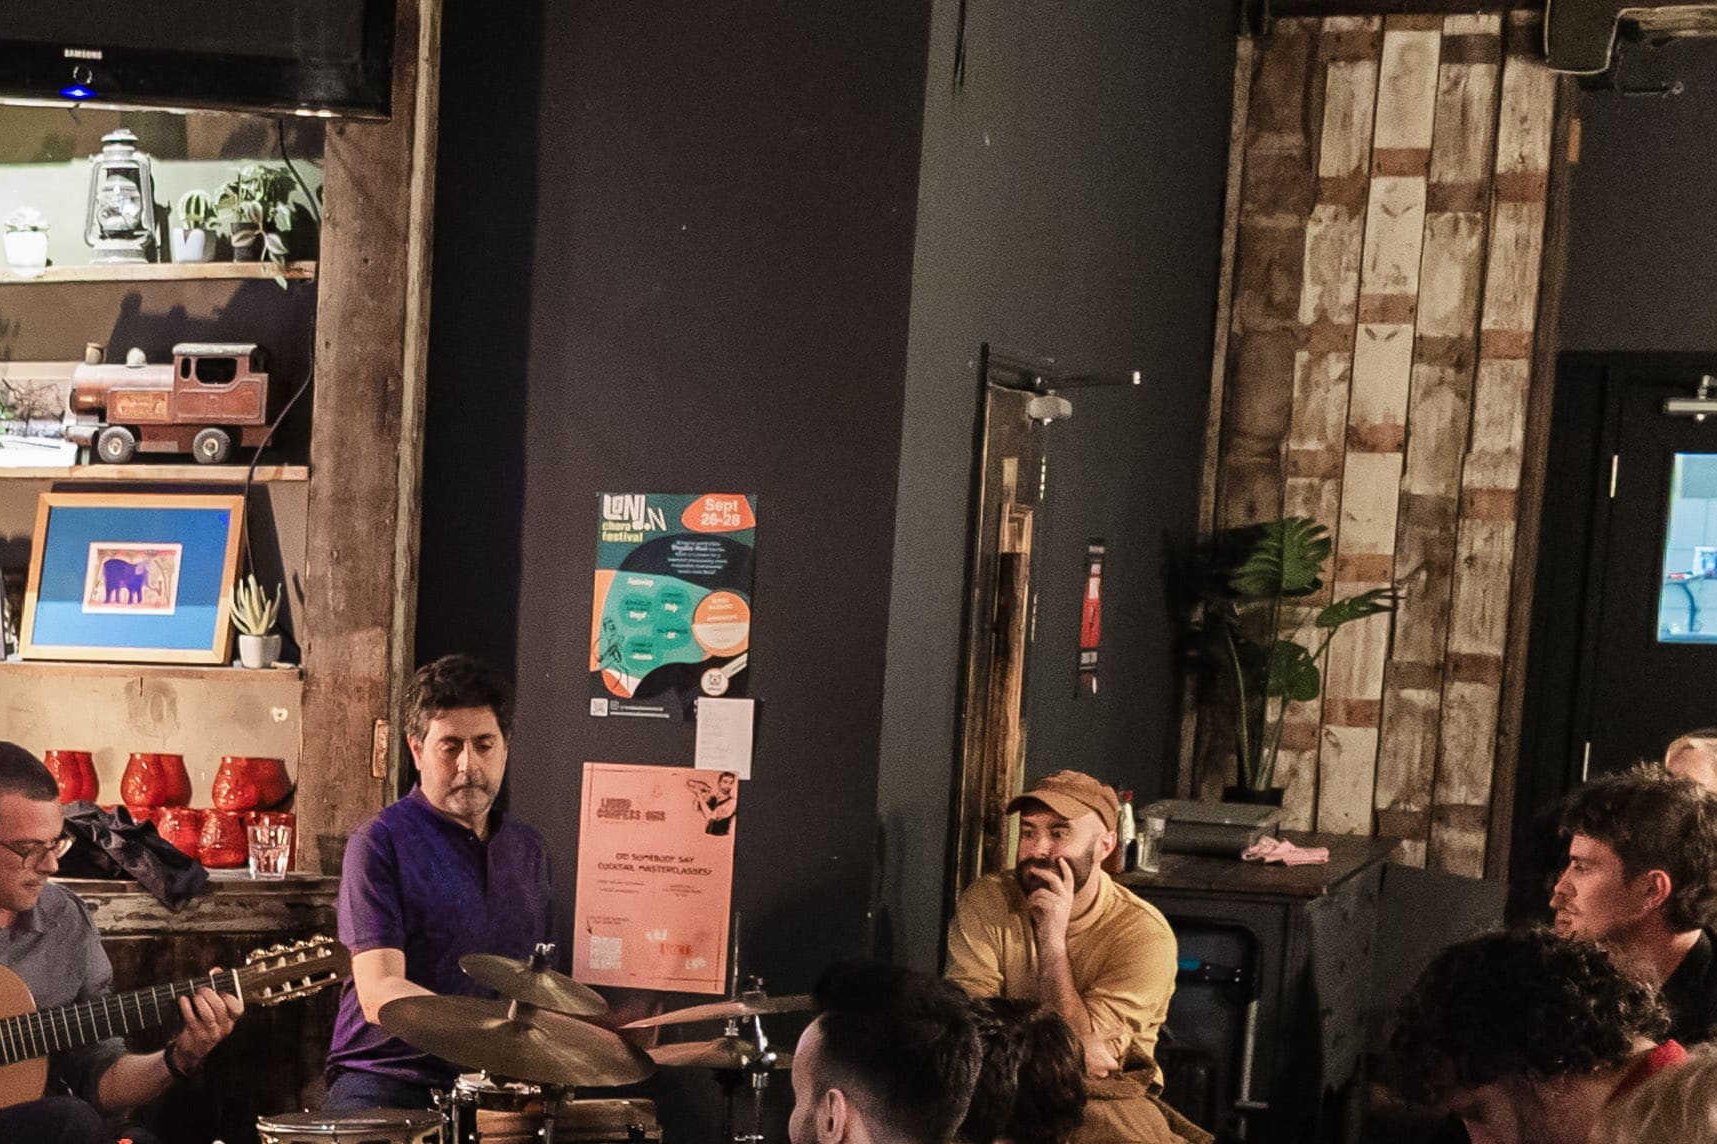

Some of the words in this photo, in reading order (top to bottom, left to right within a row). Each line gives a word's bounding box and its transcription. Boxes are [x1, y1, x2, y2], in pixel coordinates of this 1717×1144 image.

[64, 49, 102, 59] SAMSUNG
[705, 498, 739, 517] Sept
[701, 513, 741, 527] 26-28
[602, 521, 630, 531] choro
[602, 531, 643, 542] festival
[631, 853, 676, 863] SOMEBODY
[677, 856, 695, 864] SAY
[597, 861, 636, 873] COCKTAIL
